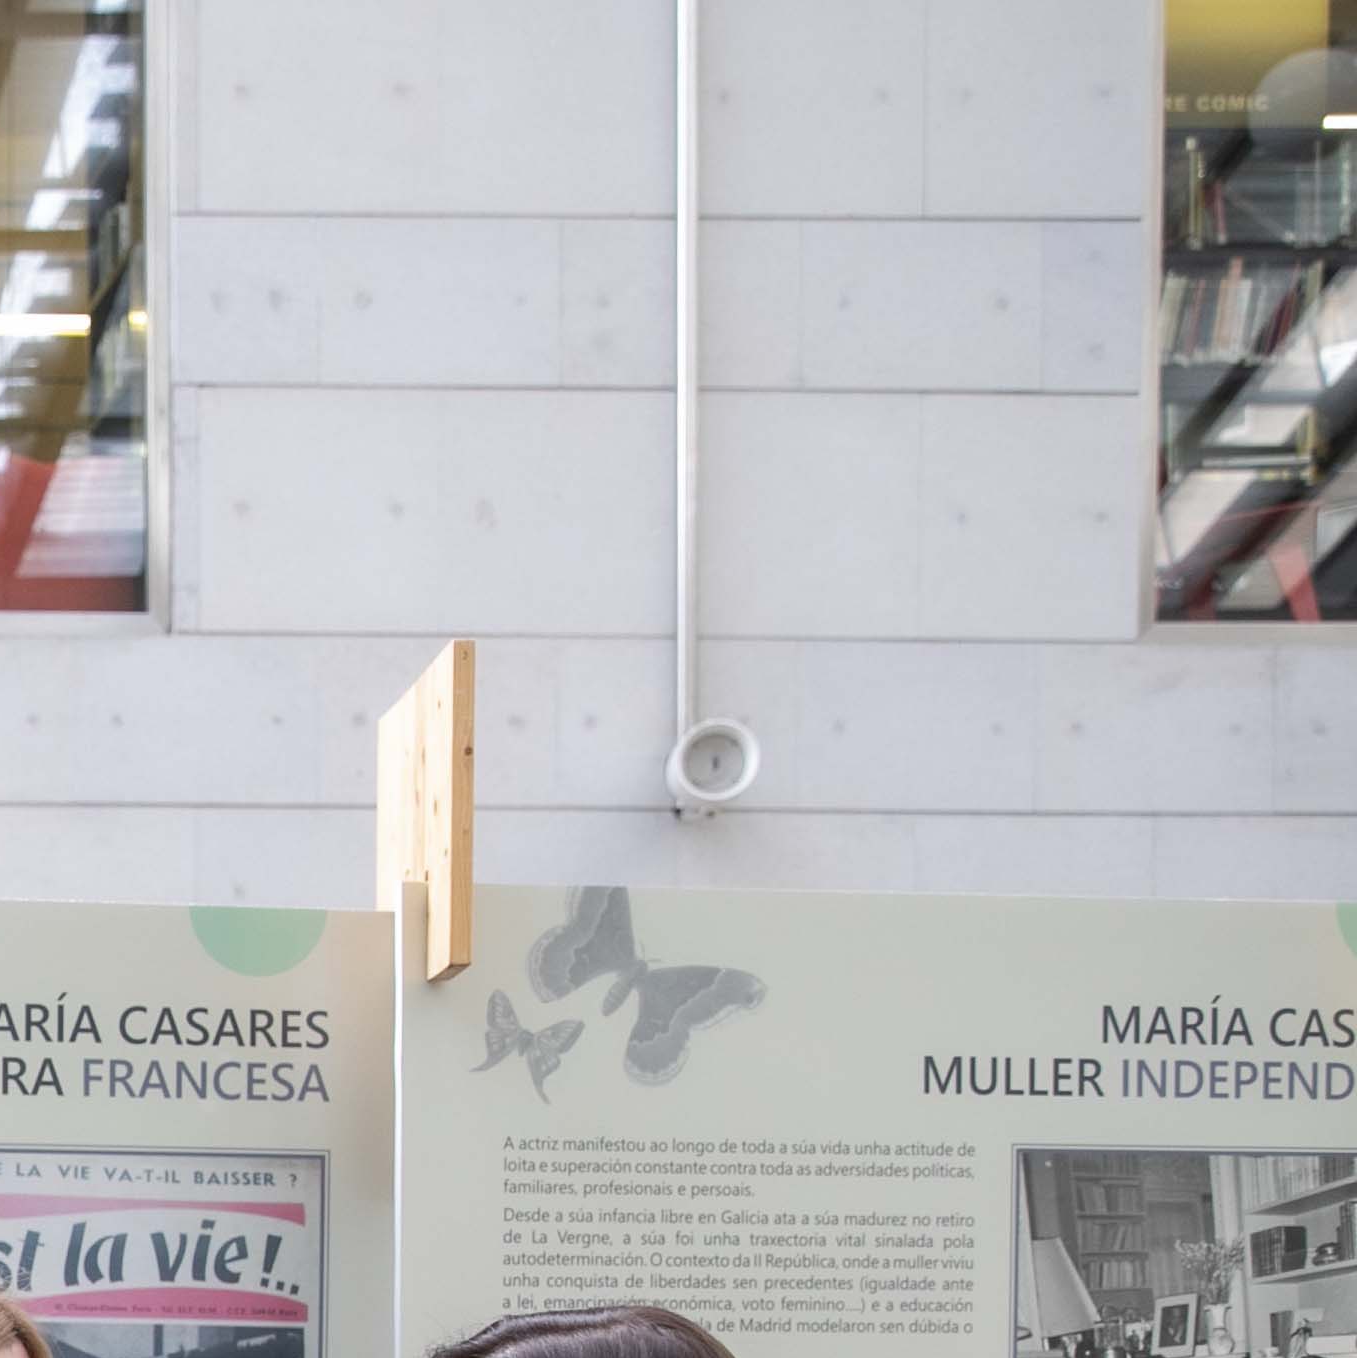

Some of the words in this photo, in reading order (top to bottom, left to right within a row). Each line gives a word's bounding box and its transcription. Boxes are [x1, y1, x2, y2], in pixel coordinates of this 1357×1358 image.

[118, 1005, 329, 1049] CASARES
[1102, 994, 1254, 1046] MARÍA
[1269, 1007, 1355, 1048] CAS
[83, 1058, 330, 1102] FRANCESA
[923, 1055, 1104, 1097] MULLER
[1122, 1059, 1355, 1100] INDEPEND
[502, 1135, 515, 1150] A
[517, 1135, 559, 1151] actriz
[562, 1135, 646, 1152] manifestou
[648, 1140, 669, 1152] ao
[671, 1137, 716, 1157] longo
[718, 1137, 738, 1154] de
[741, 1138, 775, 1154] toda
[778, 1142, 788, 1154] a
[790, 1139, 817, 1155] súa
[819, 1139, 851, 1156] vida
[853, 1139, 891, 1156] unha
[893, 1141, 954, 1157] actitude
[956, 1141, 976, 1157] de
[15, 1162, 42, 1178] LA
[57, 1164, 90, 1180] VIE
[103, 1167, 181, 1184] VA-T-IL
[193, 1169, 276, 1187] BAISSER
[288, 1173, 298, 1188] ?
[503, 1178, 578, 1196] familiares,
[582, 1179, 673, 1199] profesionais
[676, 1184, 687, 1196] e
[690, 1181, 755, 1200] persoais.
[64, 1222, 127, 1287] la
